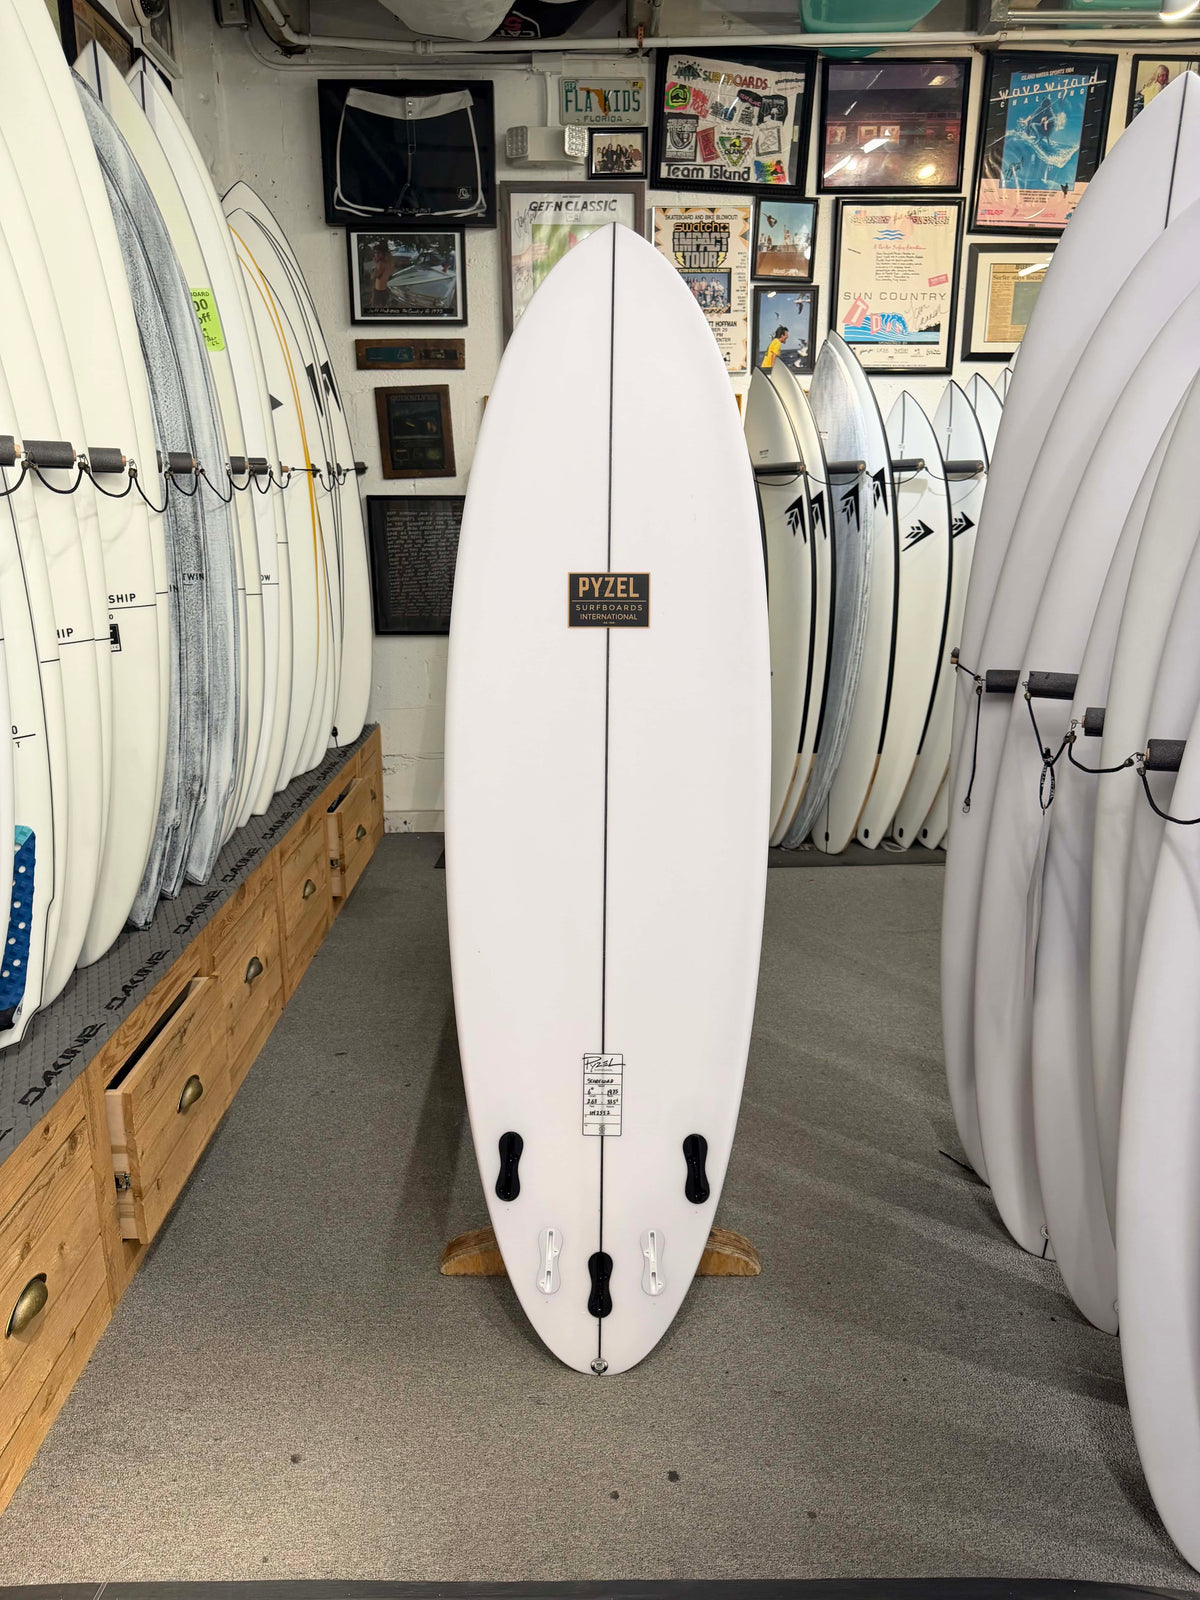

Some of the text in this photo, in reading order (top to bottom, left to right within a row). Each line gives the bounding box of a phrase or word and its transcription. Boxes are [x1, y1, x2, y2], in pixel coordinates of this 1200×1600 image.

[999, 66, 1099, 100] wave wizard
[564, 89, 641, 113] FLA KIDS
[1000, 86, 1095, 108] CHALLENGE
[583, 115, 623, 123] FLORIDA
[665, 163, 751, 181] Team Island
[564, 199, 618, 212] CLASSIC
[674, 221, 720, 232] swatch
[672, 231, 730, 252] IMPACT
[684, 251, 718, 268] TOUR
[843, 292, 947, 301] SUN COUNTRY
[198, 312, 211, 325] off
[183, 573, 204, 581] TWIN
[578, 576, 640, 598] PYZEL
[108, 593, 136, 604] SHIP
[579, 613, 638, 621] INTERNATIONAL
[261, 811, 295, 840] DAKINE
[221, 846, 262, 883] DAKINE
[172, 888, 224, 935] DAKINE
[104, 949, 171, 1011] DAKINE
[18, 1022, 106, 1107] DAKINE
